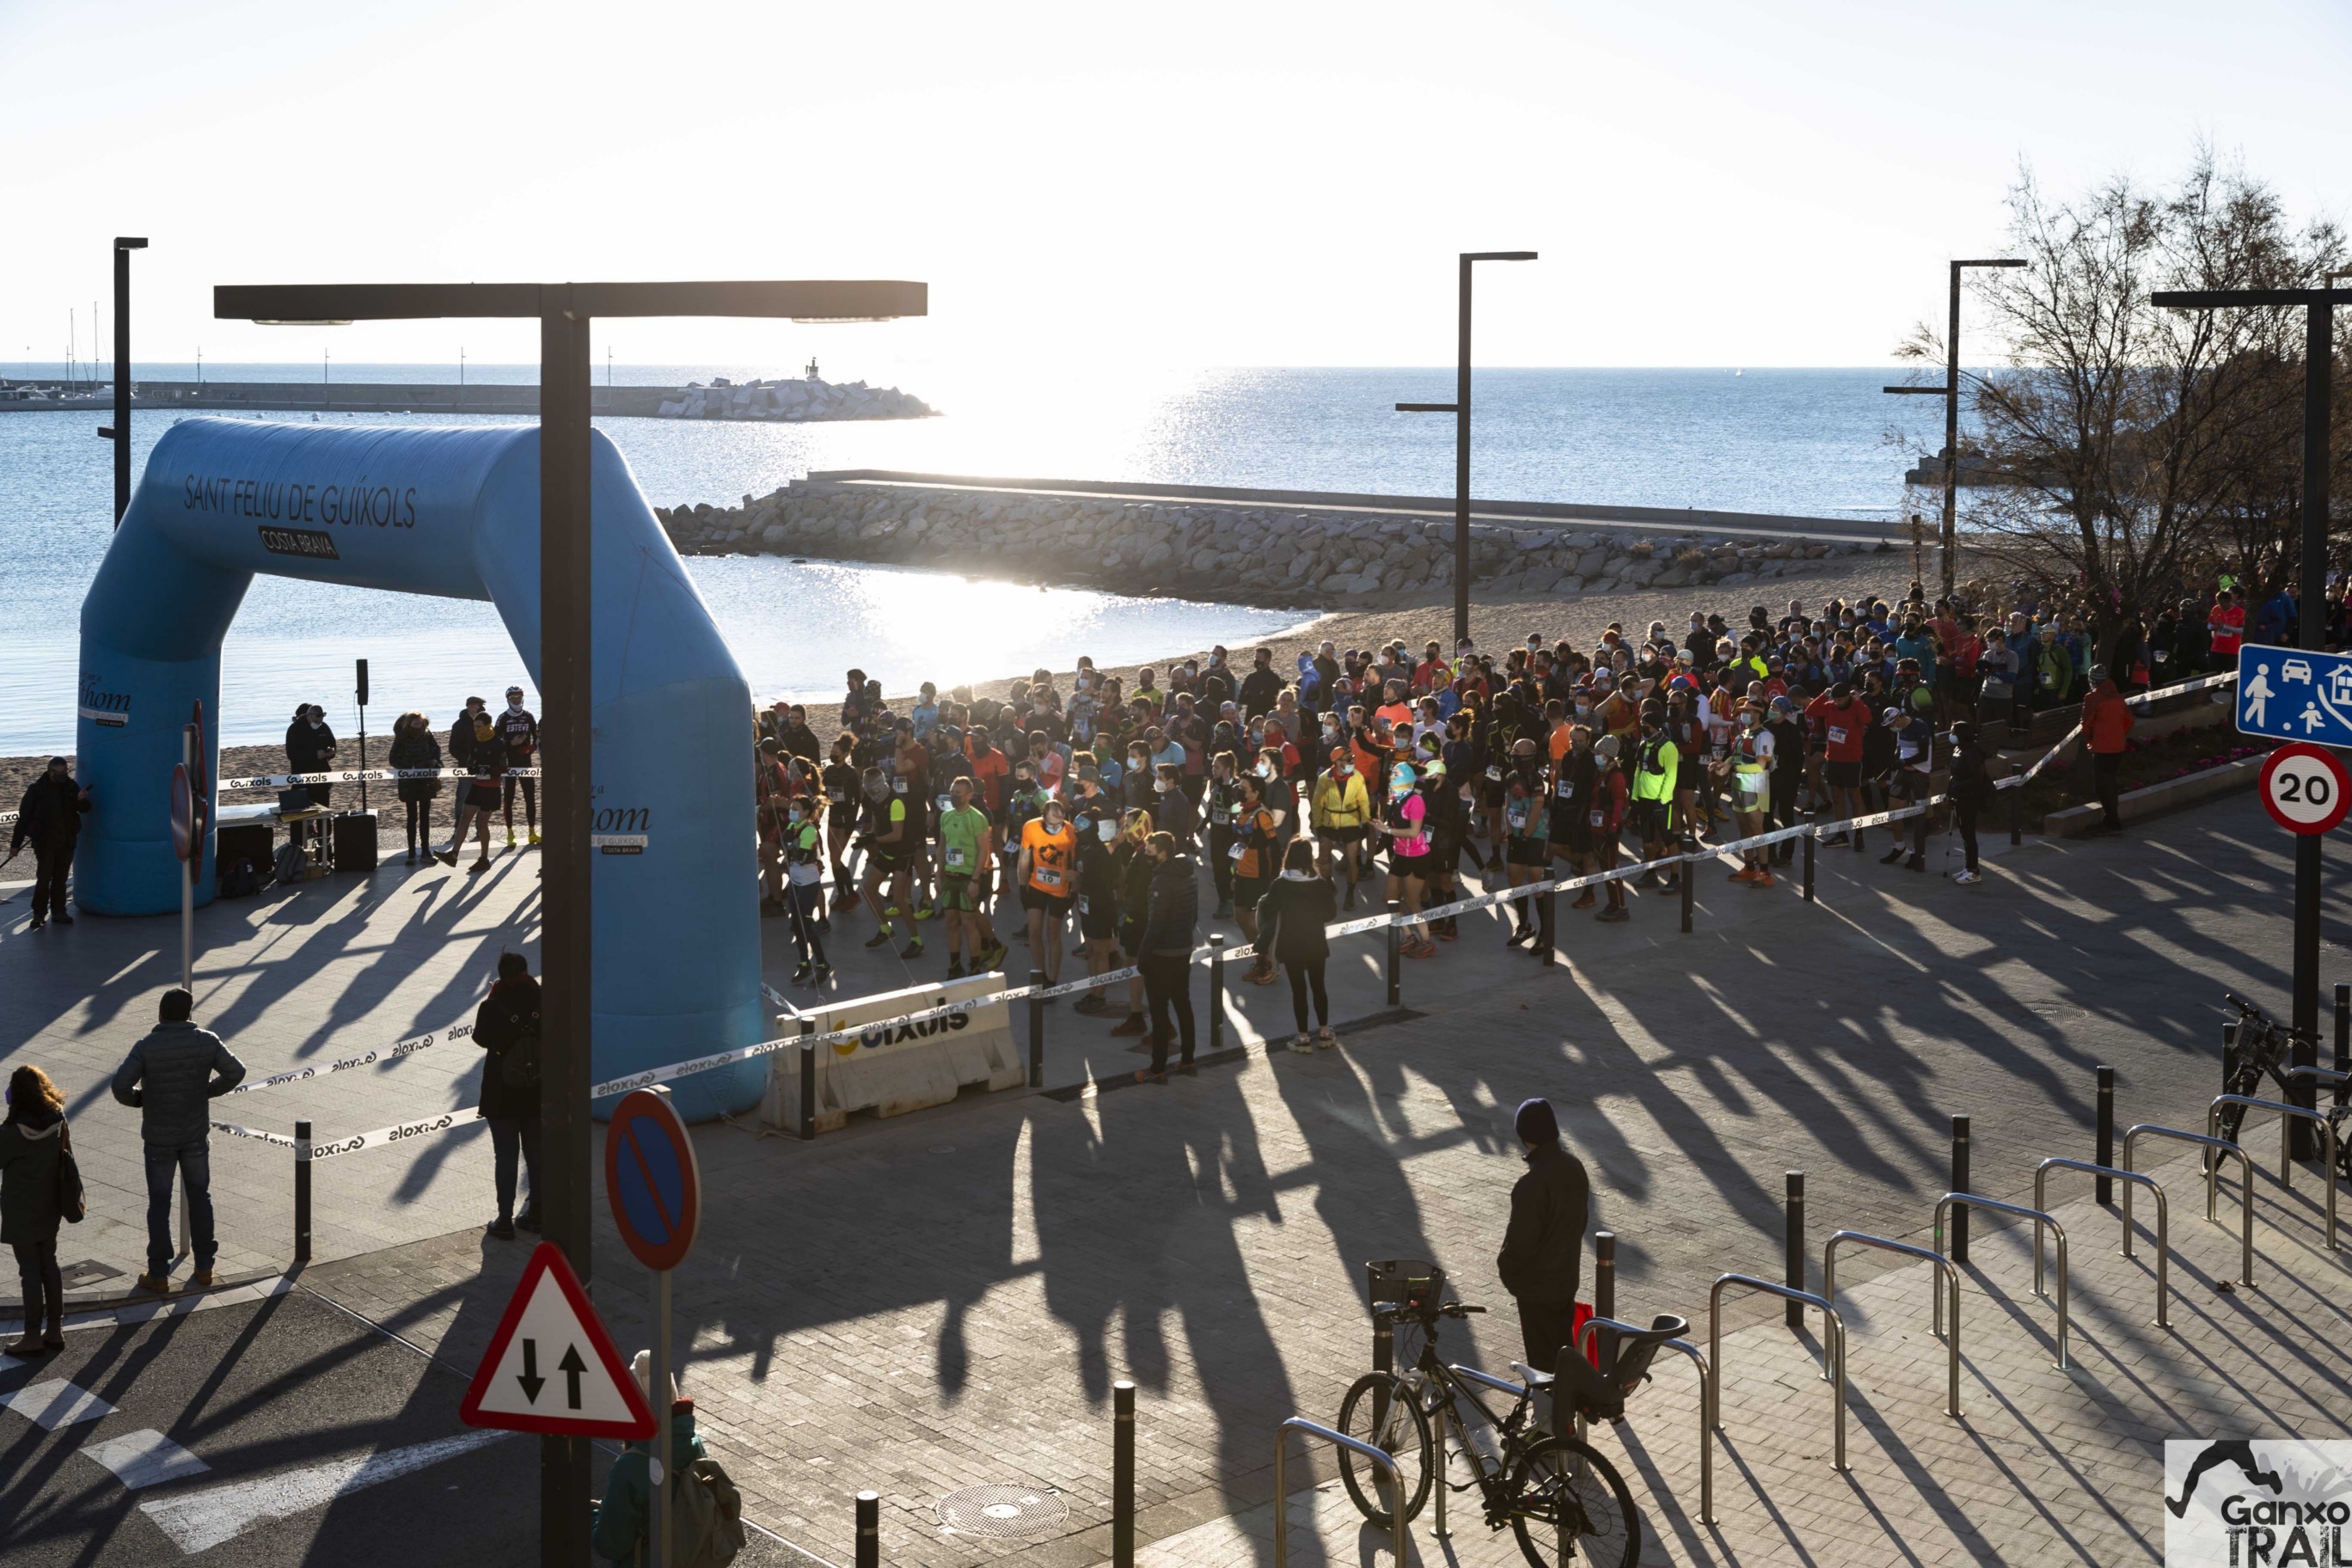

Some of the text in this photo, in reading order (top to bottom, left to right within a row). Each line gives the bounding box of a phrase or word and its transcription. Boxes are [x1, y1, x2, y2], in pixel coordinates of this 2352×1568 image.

[184, 475, 416, 529] SANT FELIU DE GUÍXOLS
[261, 530, 337, 556] COSTA BRAVA
[2279, 773, 2330, 805] 20
